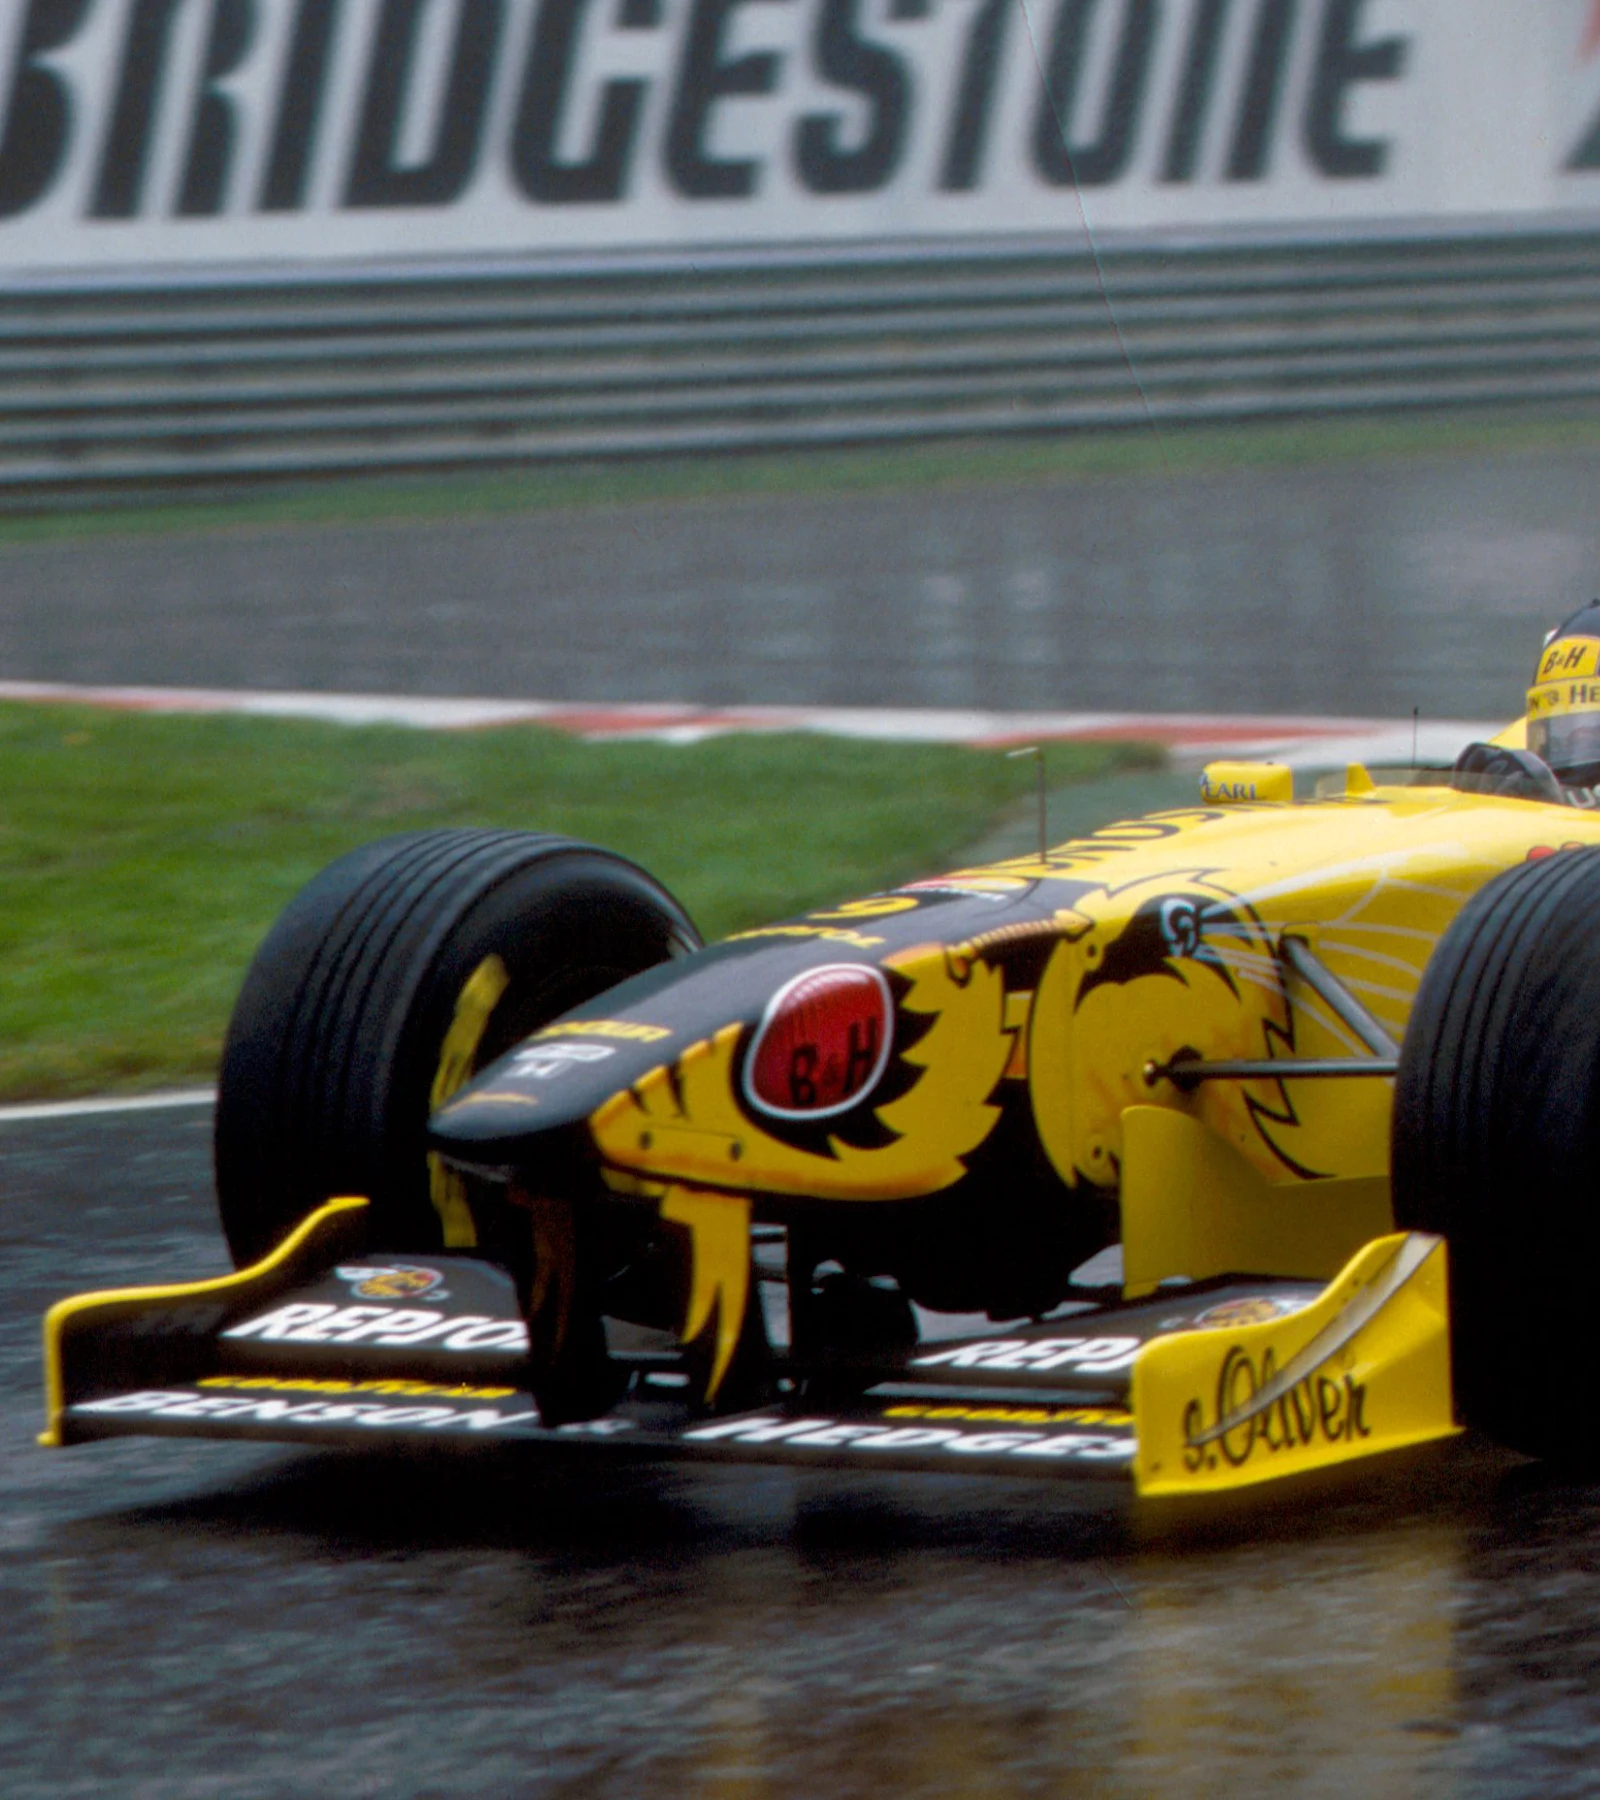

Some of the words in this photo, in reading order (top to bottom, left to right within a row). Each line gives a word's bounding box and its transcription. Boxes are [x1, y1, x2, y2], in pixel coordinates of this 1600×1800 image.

[0, 0, 1410, 224] BRIDGESTONE
[66, 1389, 542, 1430] BENSON
[678, 1416, 1140, 1459] HEDGES
